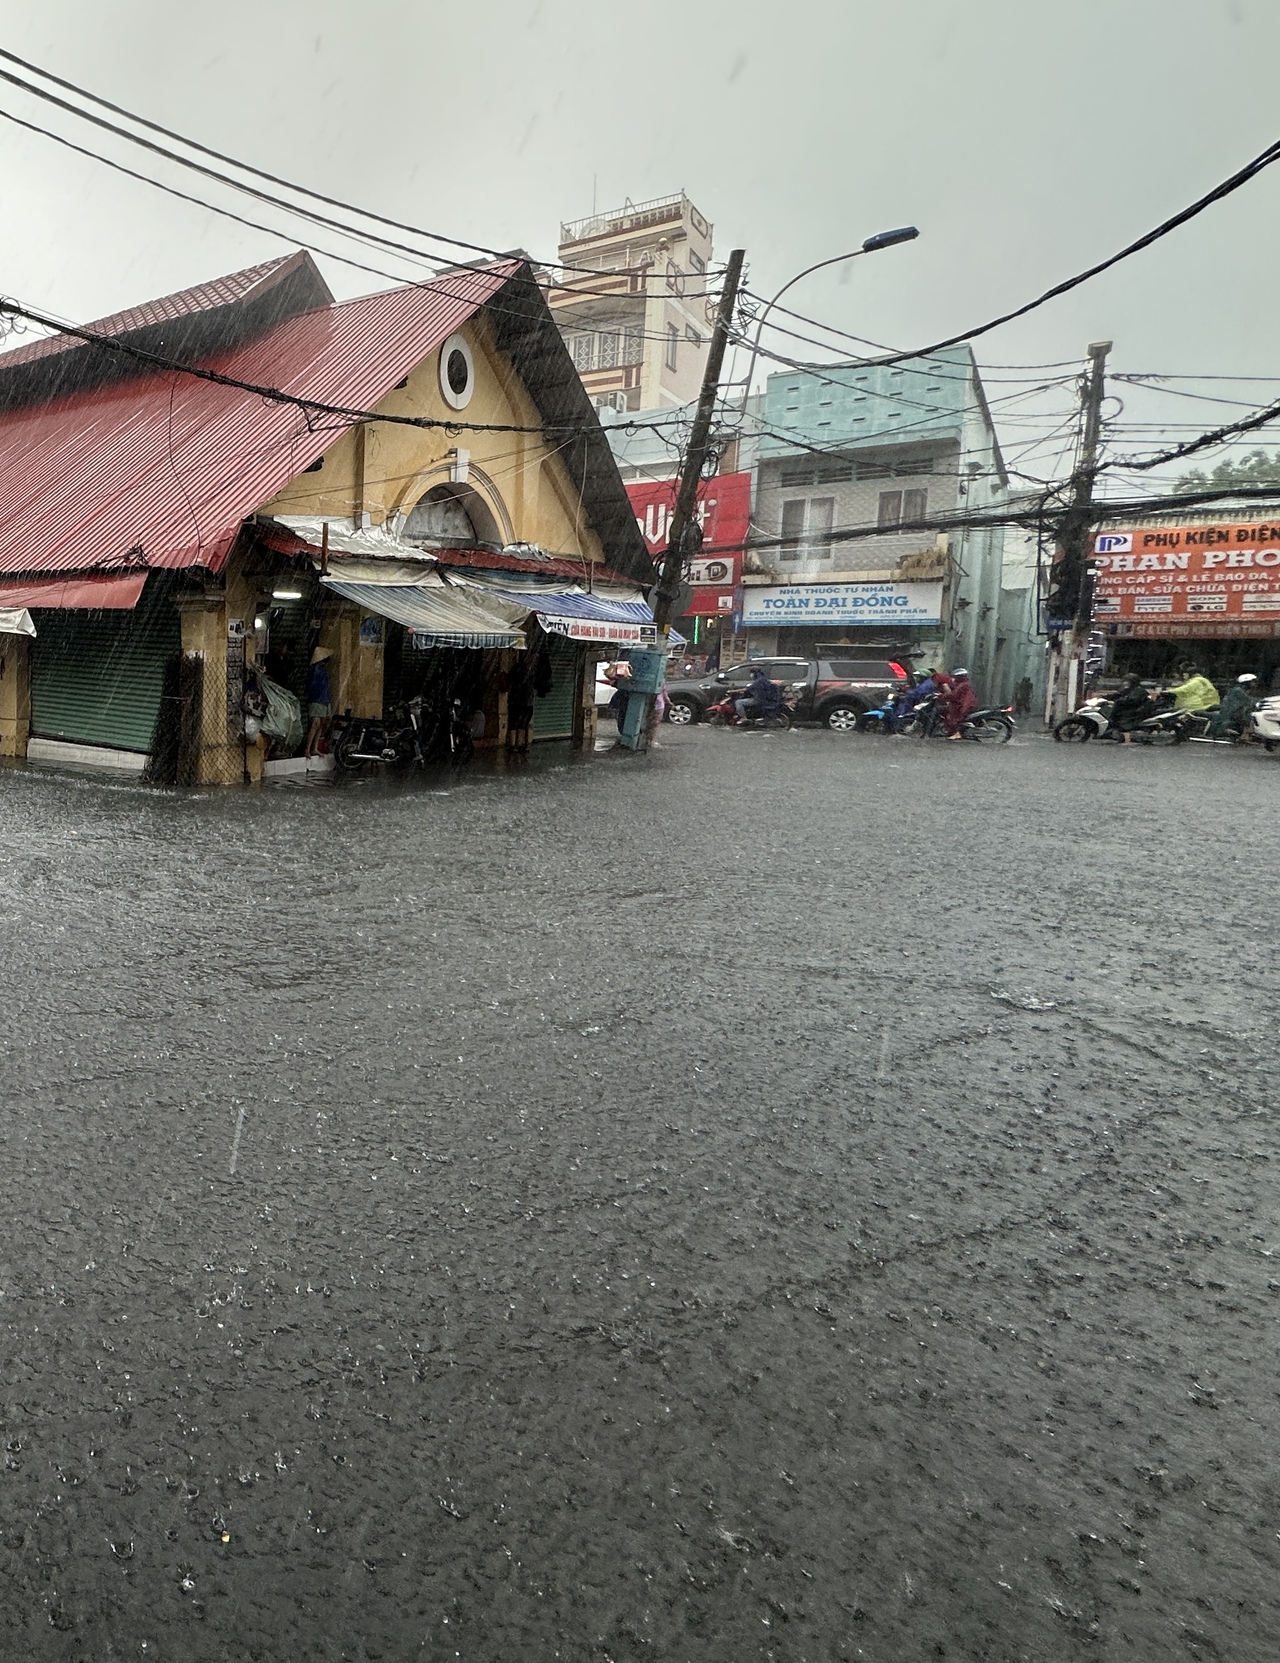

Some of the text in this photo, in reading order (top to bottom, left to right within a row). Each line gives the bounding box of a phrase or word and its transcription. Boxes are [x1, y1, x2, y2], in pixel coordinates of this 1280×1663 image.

[1143, 533, 1180, 549] PHỤ
[1185, 528, 1230, 547] KIỆN
[1214, 573, 1245, 582] BAO
[763, 596, 810, 609] TOÀN
[814, 597, 848, 610] ĐẠI
